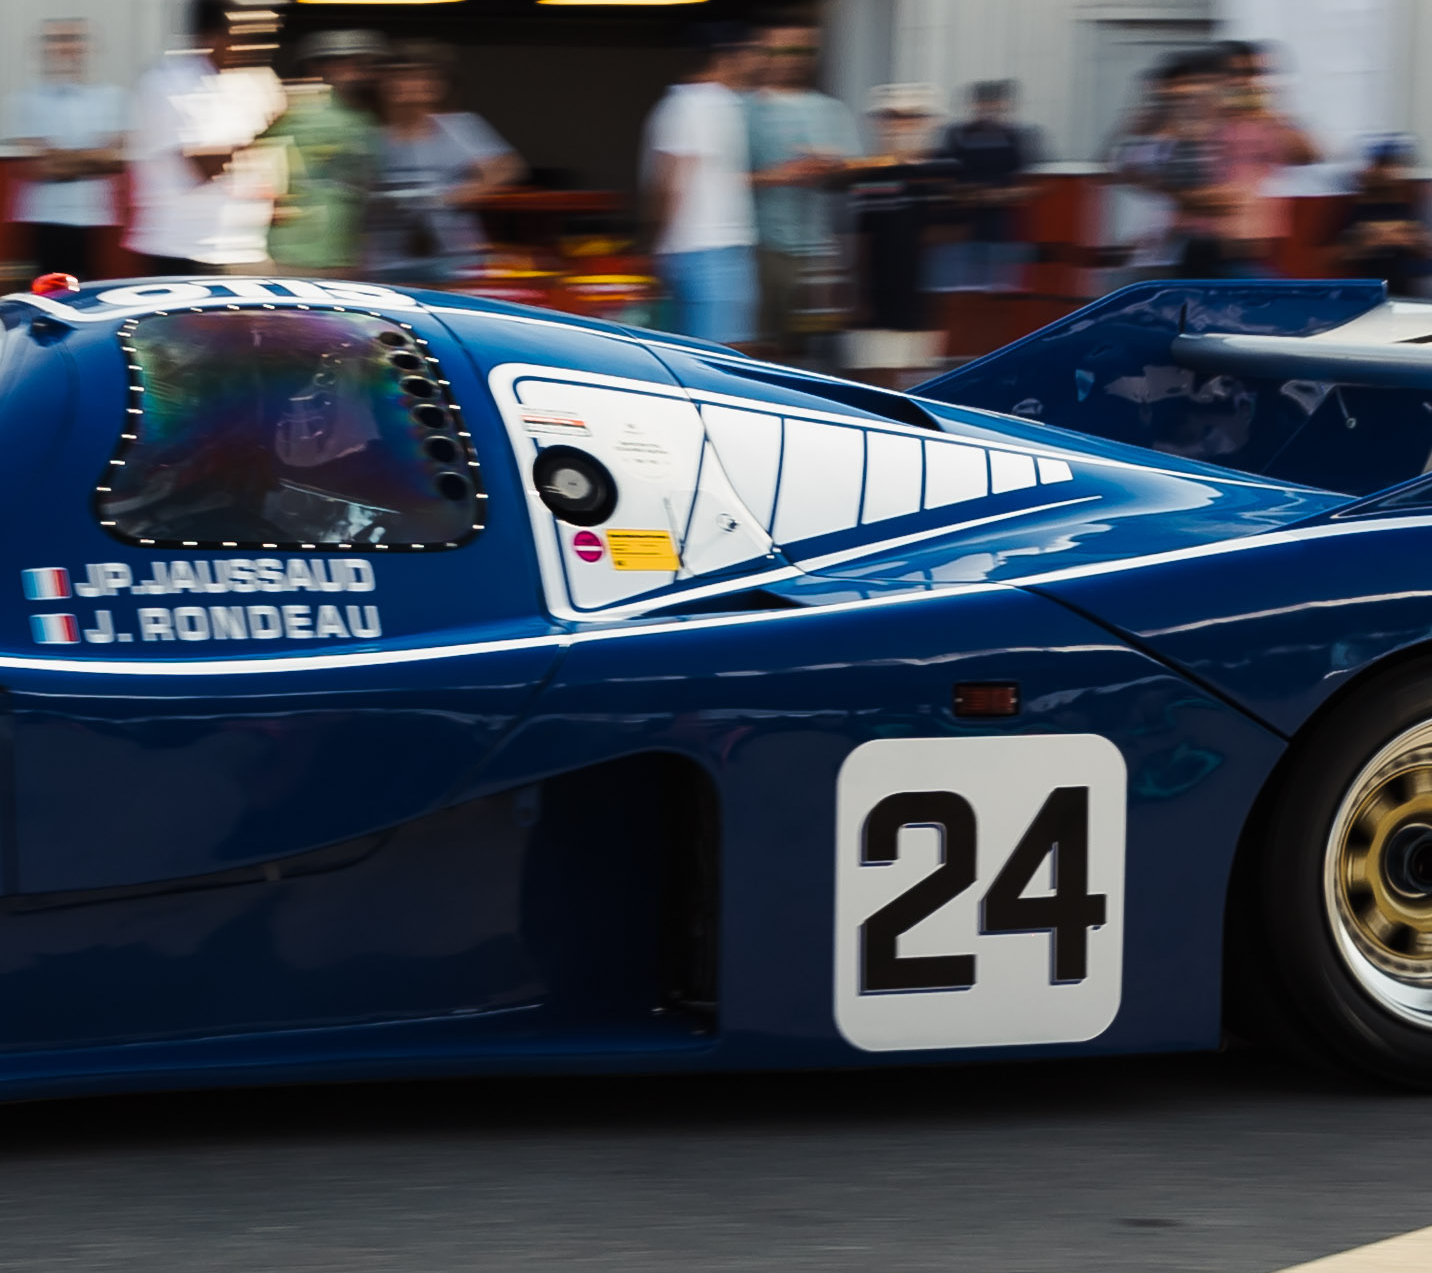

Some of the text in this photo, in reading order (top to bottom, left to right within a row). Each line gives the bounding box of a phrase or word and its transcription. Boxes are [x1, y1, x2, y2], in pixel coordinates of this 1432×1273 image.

[95, 278, 417, 307] OTIS
[137, 604, 383, 642] RONDEAU
[856, 785, 1108, 998] 24
